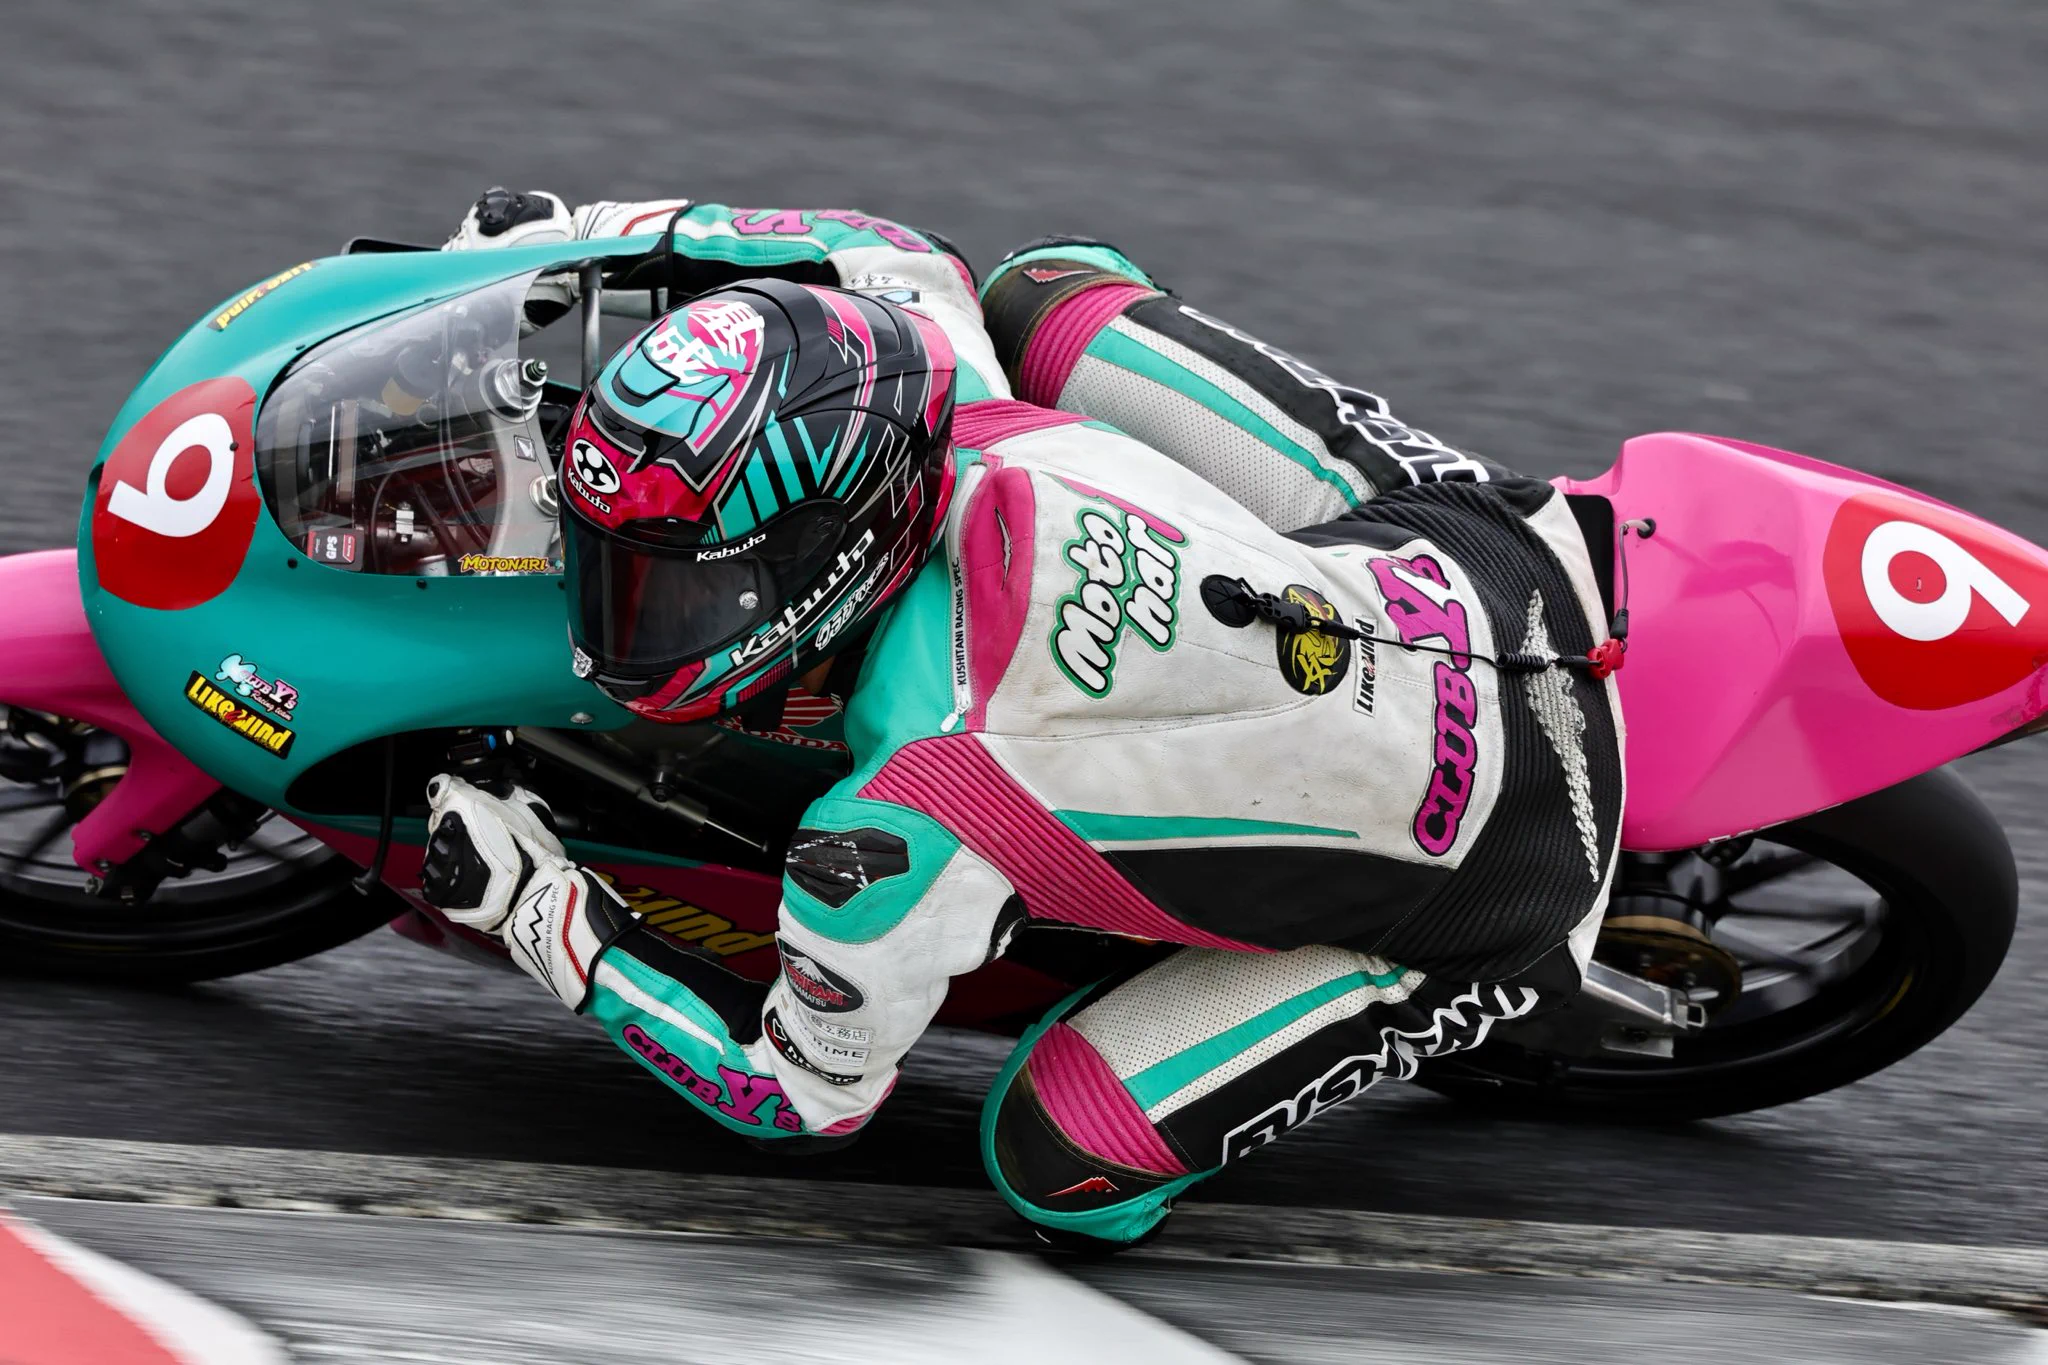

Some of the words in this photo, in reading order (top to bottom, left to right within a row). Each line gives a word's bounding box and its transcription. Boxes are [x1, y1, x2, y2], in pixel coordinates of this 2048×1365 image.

[567, 468, 612, 514] Kabuto
[325, 535, 338, 560] GPS
[460, 554, 548, 572] MOTONARI
[696, 533, 767, 562] Kabuto
[731, 528, 876, 667] Kabuto
[954, 589, 964, 629] RACING
[1055, 511, 1127, 694] Moto
[954, 631, 967, 686] KUSHITANI
[250, 690, 275, 712] Racing
[275, 706, 292, 721] team
[1413, 660, 1478, 857] CLUB
[551, 884, 560, 903] SPEC
[546, 905, 556, 935] RACING
[545, 936, 554, 976] KUSHITANI
[623, 1024, 723, 1106] CLUB
